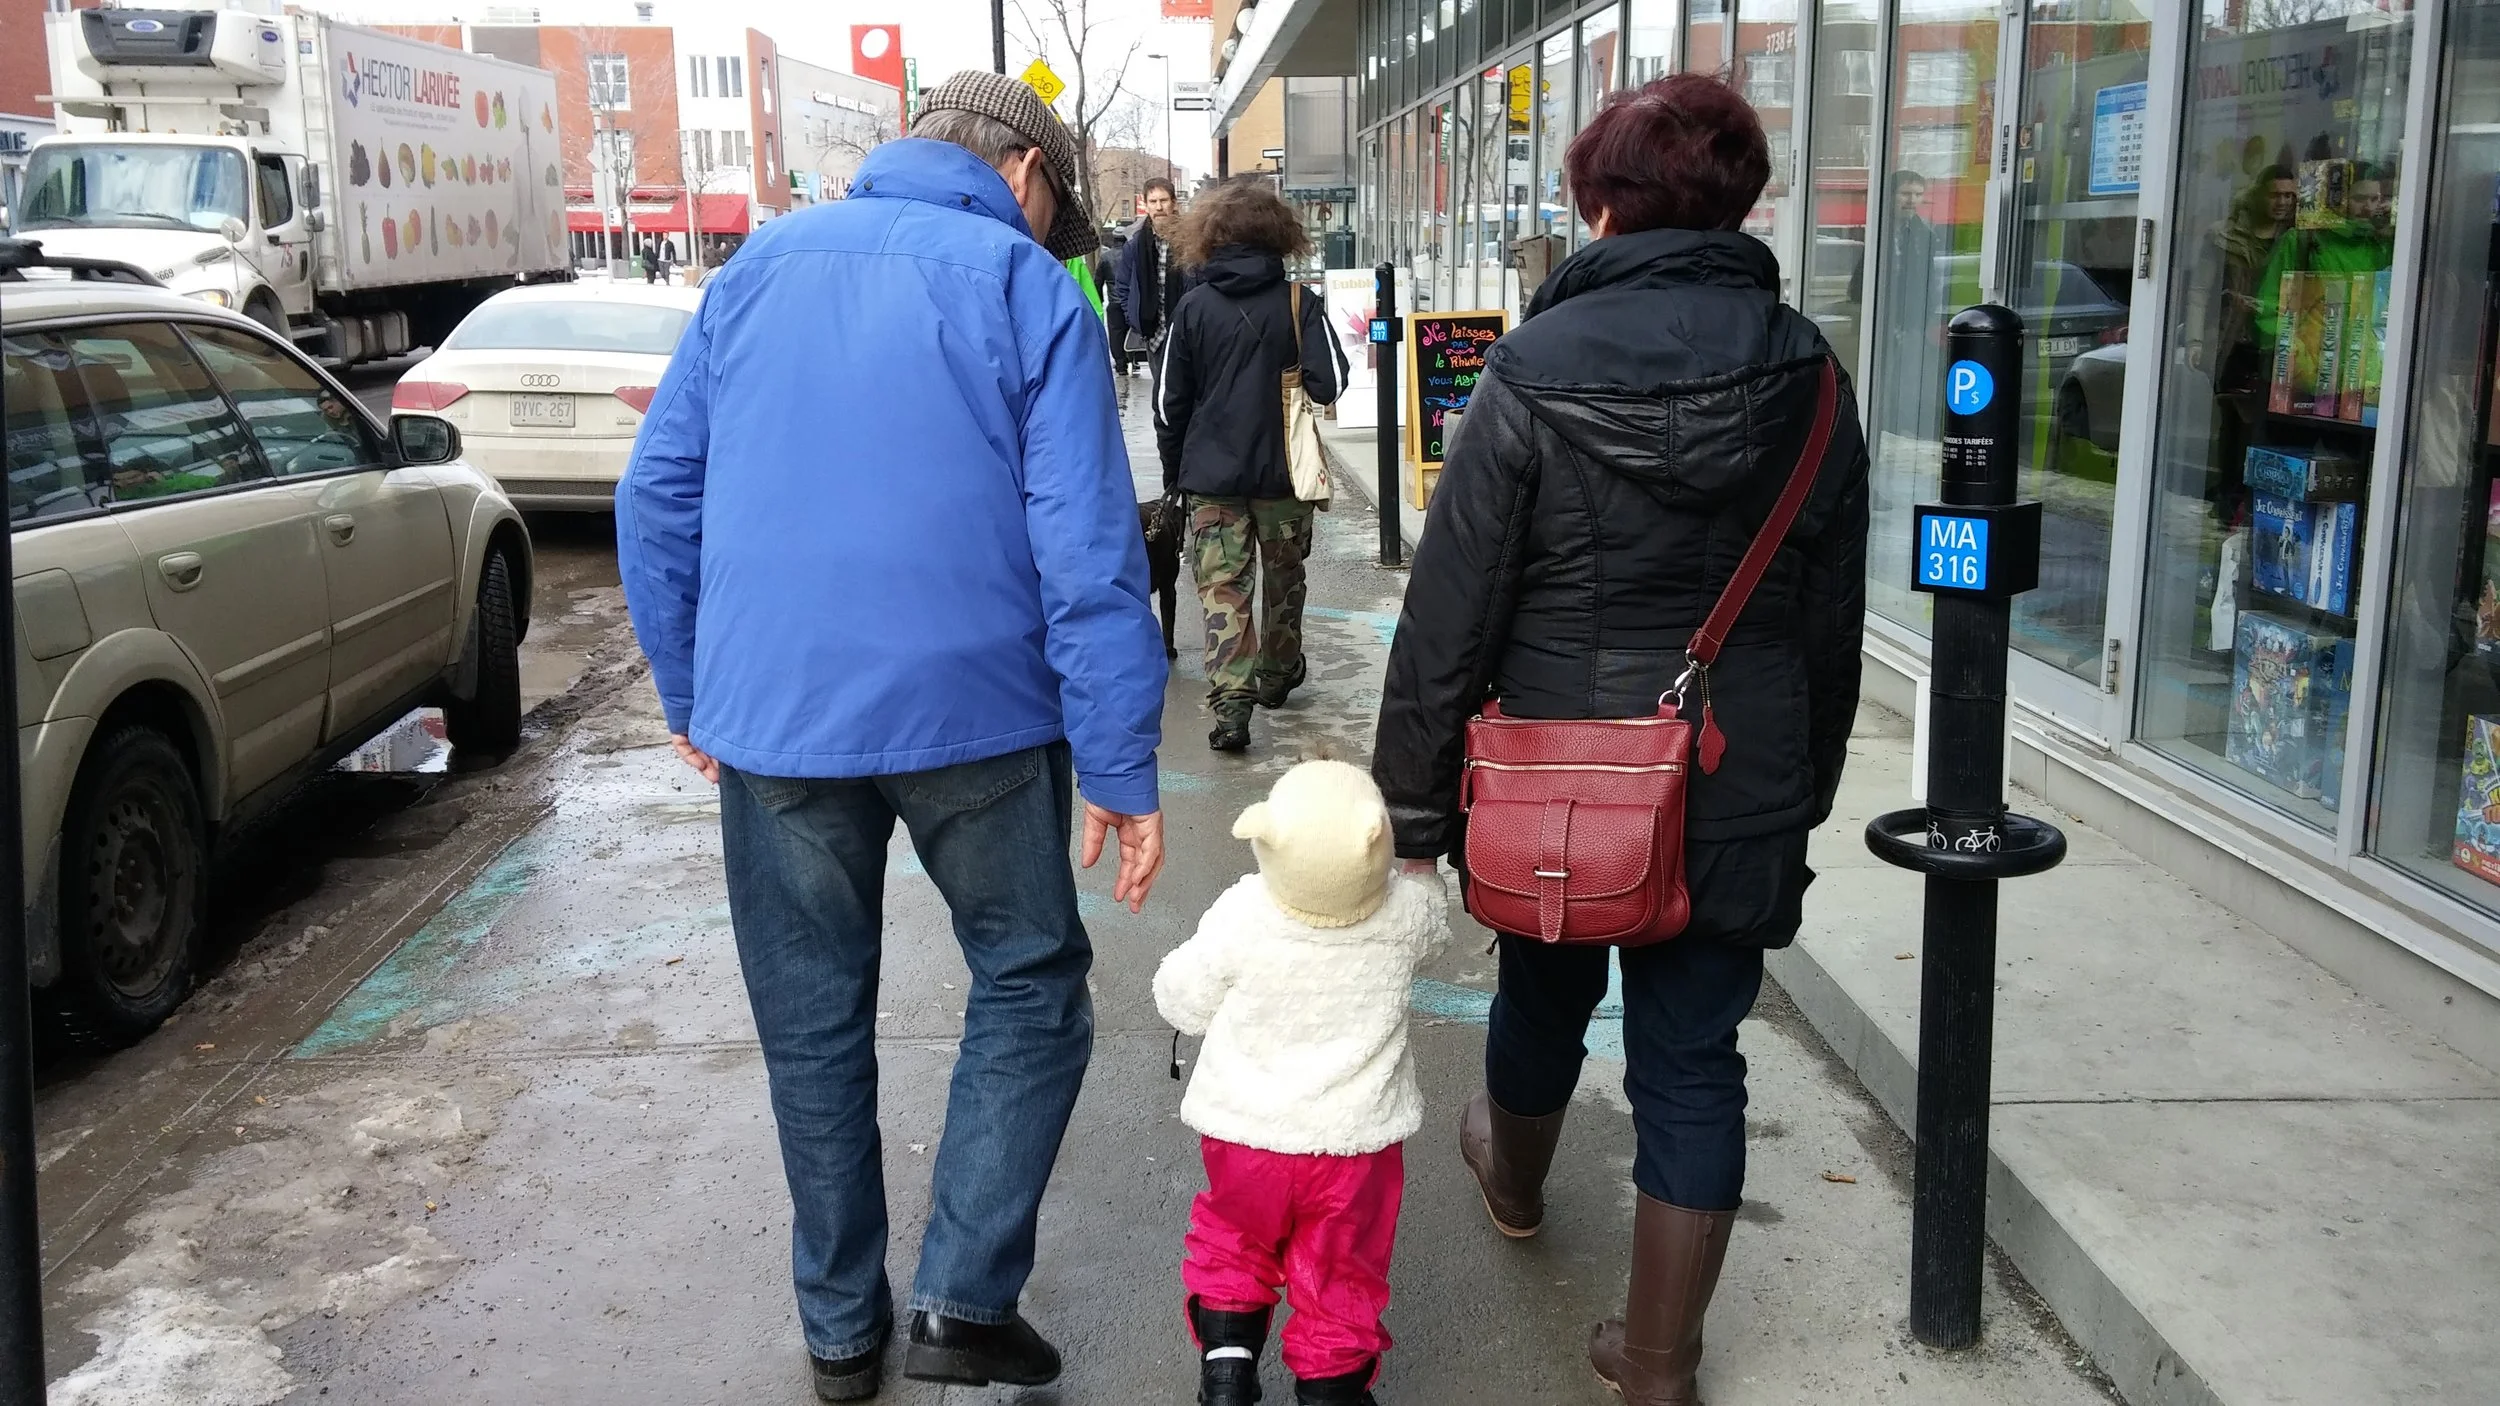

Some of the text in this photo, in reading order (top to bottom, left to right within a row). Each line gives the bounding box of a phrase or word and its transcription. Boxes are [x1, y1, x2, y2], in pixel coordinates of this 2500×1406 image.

[361, 57, 411, 102] HECTOR
[1371, 322, 1385, 330] MA
[1372, 331, 1385, 341] 317
[1423, 322, 1496, 346] Ne laissez
[1451, 340, 1469, 349] PAS
[1435, 353, 1445, 368] le
[514, 402, 571, 417] BYVC 267
[1963, 437, 1994, 445] TARIFÉES
[1930, 518, 1978, 551] MA
[1928, 552, 1978, 585] 316
